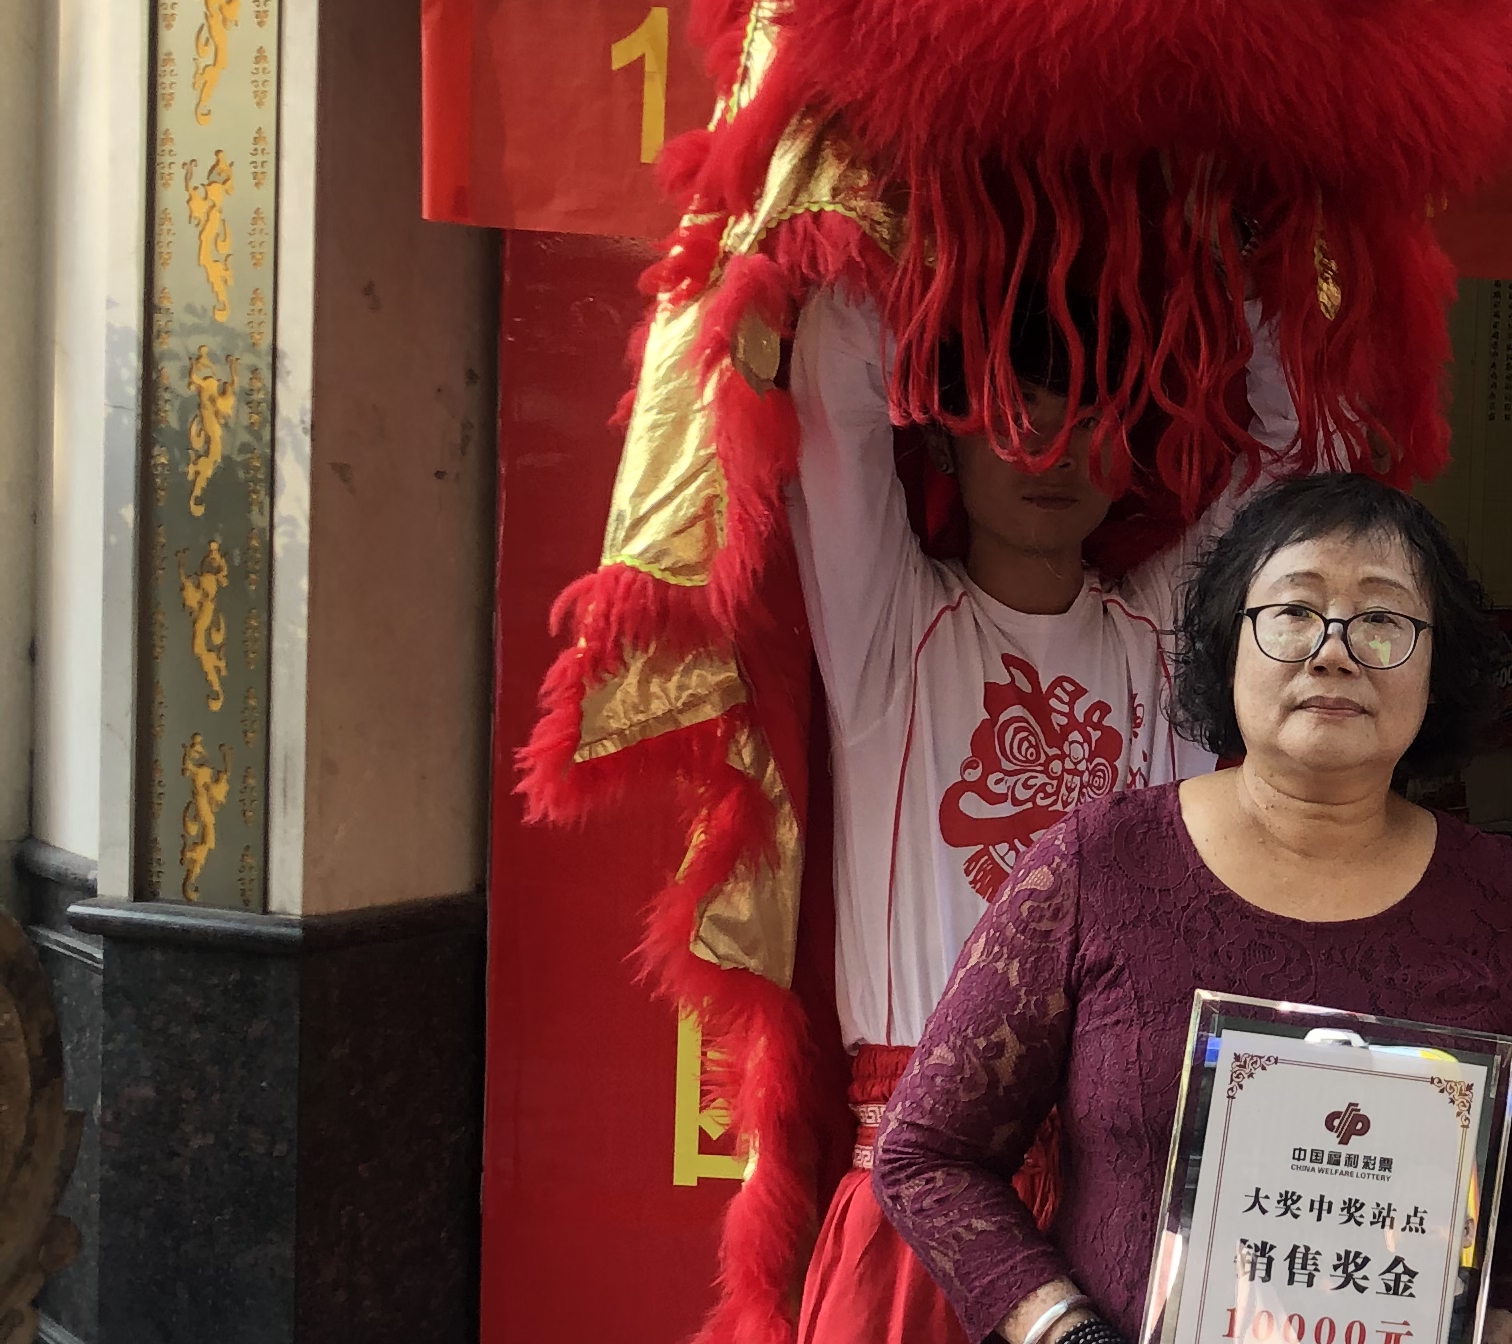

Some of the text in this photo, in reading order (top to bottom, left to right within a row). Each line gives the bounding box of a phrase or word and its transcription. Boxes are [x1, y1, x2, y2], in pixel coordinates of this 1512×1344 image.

[1290, 1163, 1392, 1182] CHINA WELFARE LOTTERY
[1291, 1146, 1394, 1173] 中国福利彩票
[1242, 1186, 1428, 1234] 大奖中奖站点
[1233, 1238, 1420, 1299] 销售奖金
